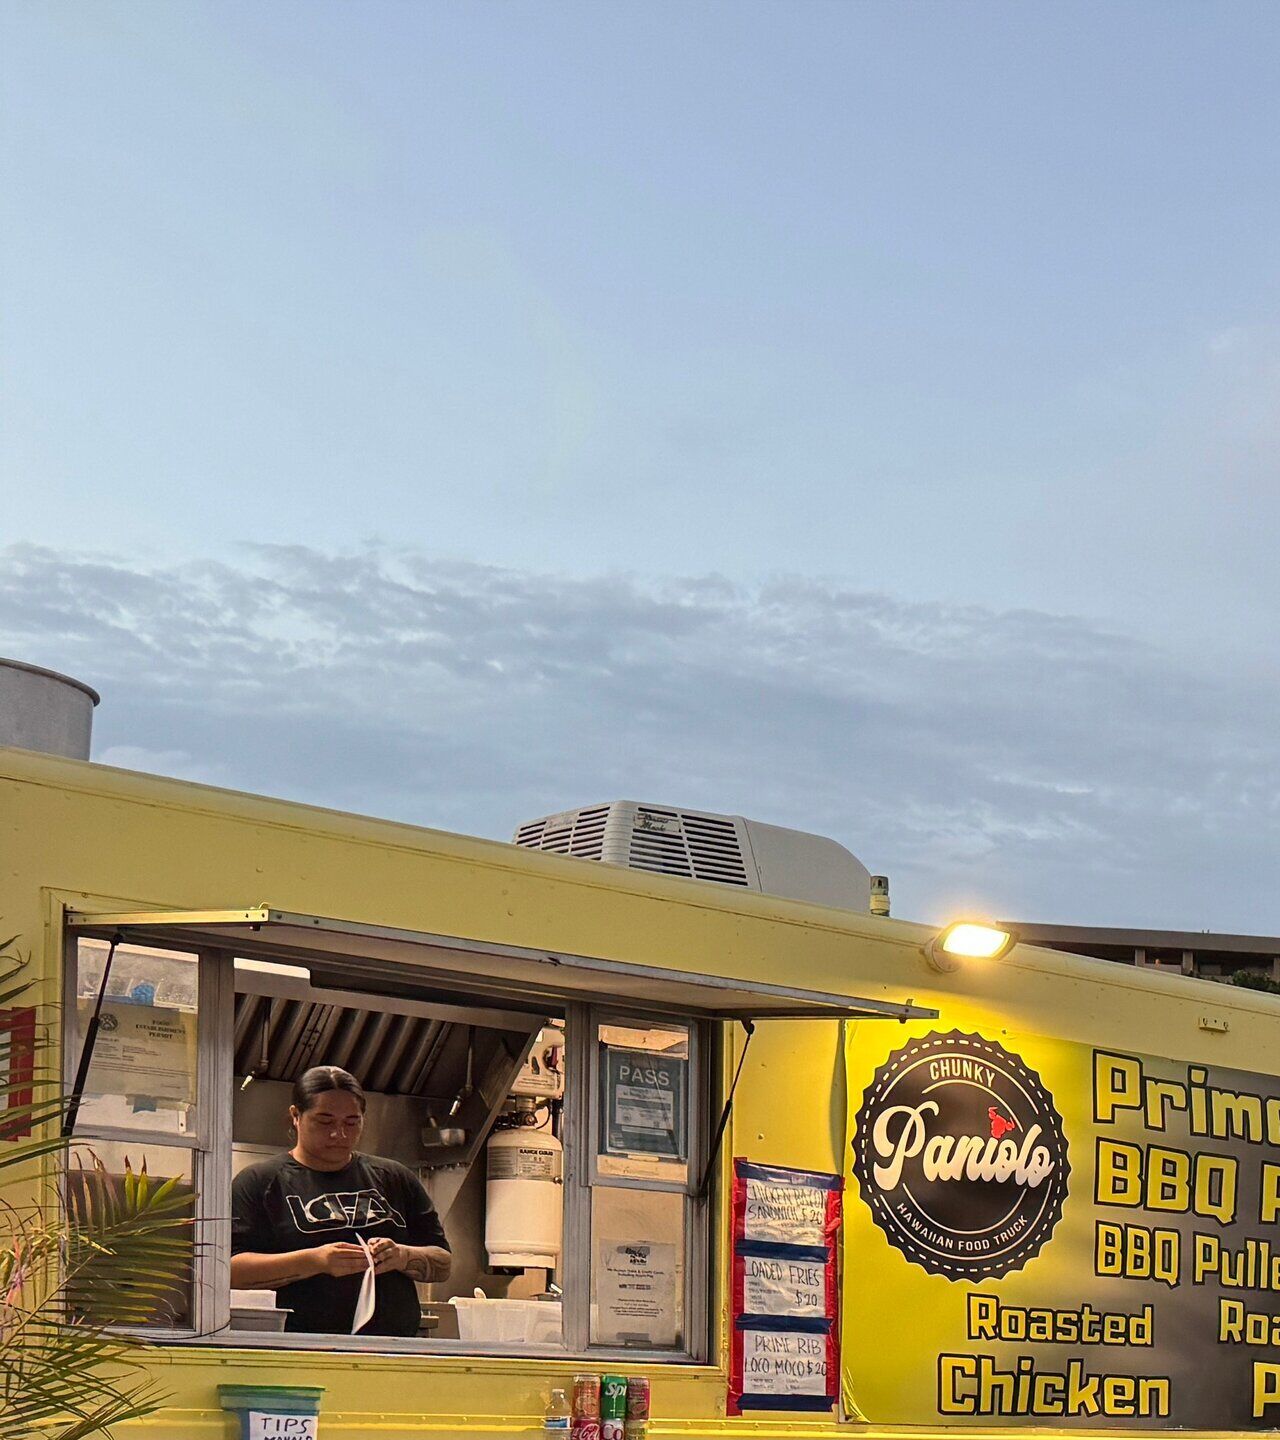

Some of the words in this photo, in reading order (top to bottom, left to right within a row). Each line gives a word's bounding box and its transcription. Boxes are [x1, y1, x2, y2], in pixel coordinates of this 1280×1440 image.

[620, 1065, 669, 1085] PASS
[930, 1059, 996, 1088] CHUNKY
[873, 1101, 1055, 1191] Paniolo
[1096, 1139, 1237, 1226] BBQ
[897, 1203, 953, 1249] HAWAIIAN
[958, 1240, 990, 1251] FOOD
[993, 1215, 1028, 1247] TRUCK
[1096, 1222, 1180, 1286] BBQ
[745, 1261, 782, 1281] LOADED
[789, 1265, 820, 1286] FRIES
[969, 1295, 1153, 1346] Roasted
[755, 1335, 789, 1353] PRIME
[798, 1337, 821, 1355] RIB
[775, 1358, 804, 1377] MOCO
[939, 1355, 1171, 1416] Chicken
[261, 1418, 311, 1434] TIPS
